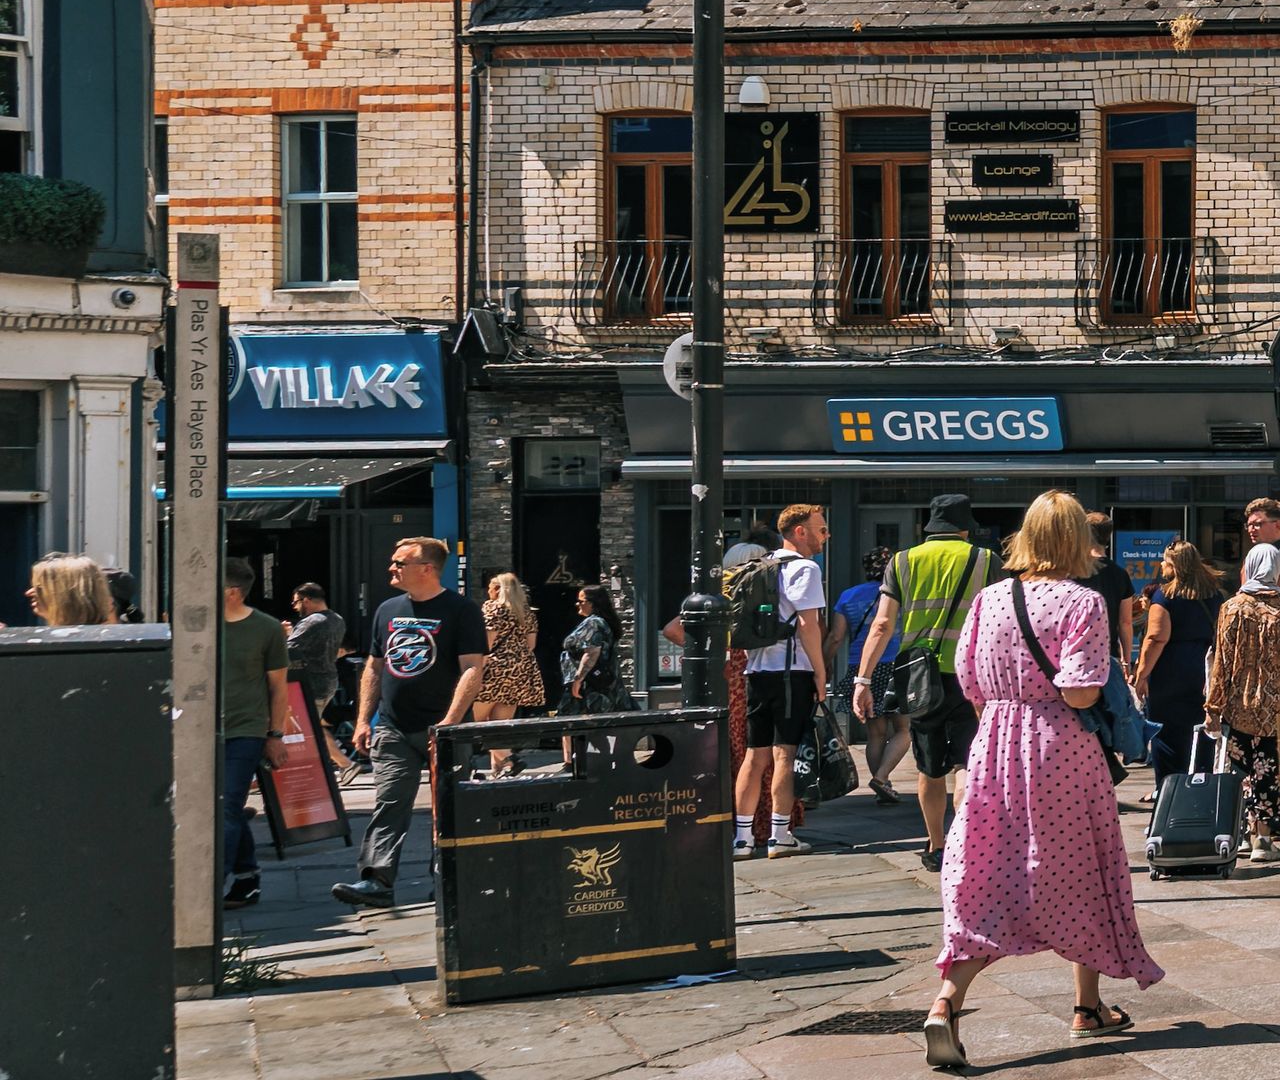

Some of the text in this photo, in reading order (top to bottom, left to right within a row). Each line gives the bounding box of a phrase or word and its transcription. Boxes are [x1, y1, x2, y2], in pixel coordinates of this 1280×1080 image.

[948, 119, 1077, 133] Cocktail Mixology
[984, 165, 1041, 177] Lounge
[948, 209, 1076, 222] www.lab22cardiff.com
[247, 363, 424, 409] VILLAGE
[186, 299, 209, 499] Plas Yr Aes Hayes Place
[882, 409, 1050, 441] GREGGS
[615, 788, 696, 806] AILGYLCHU
[490, 802, 558, 818] SBWRIEL
[614, 803, 697, 821] RECYCLING
[499, 816, 552, 832] LITTER
[574, 887, 617, 901] CARDIFF
[567, 900, 625, 915] CAERDYDD
